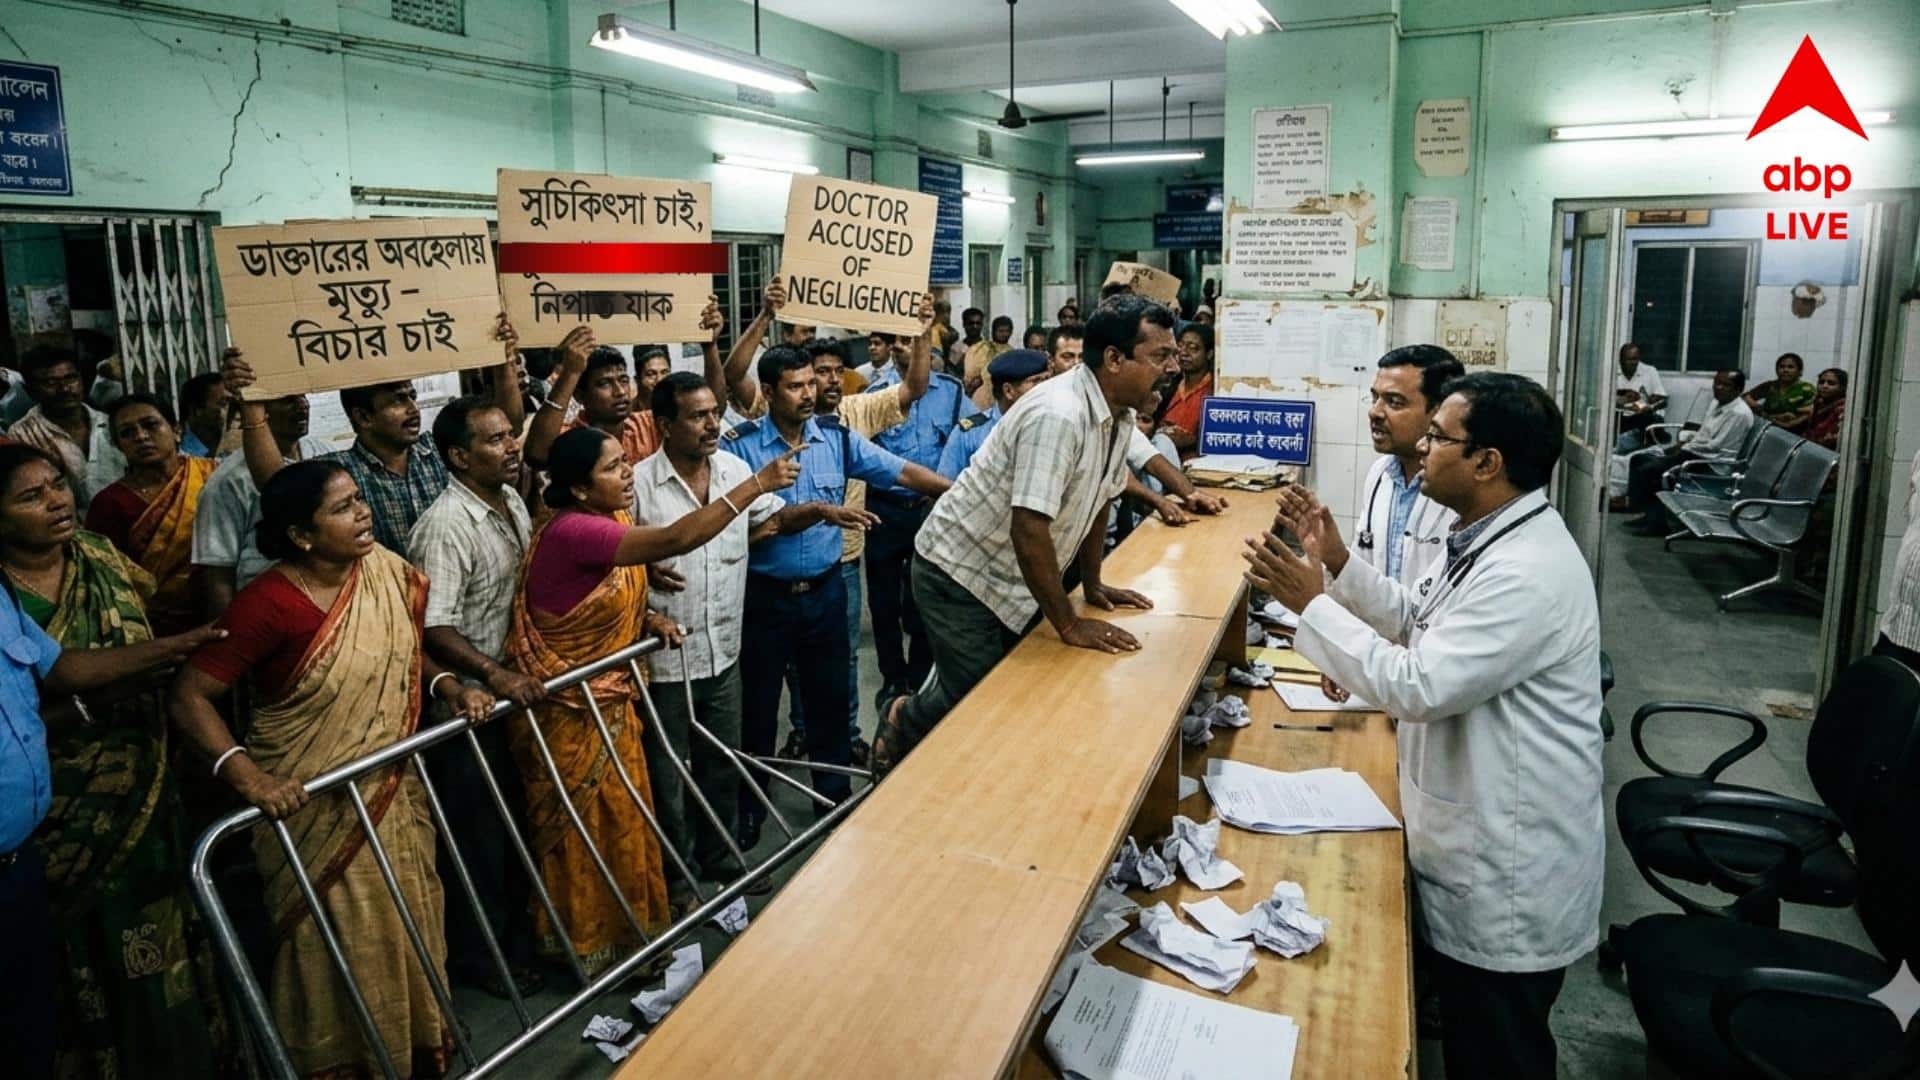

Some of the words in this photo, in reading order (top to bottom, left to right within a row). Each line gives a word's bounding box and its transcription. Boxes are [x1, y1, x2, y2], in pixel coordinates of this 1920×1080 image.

[518, 178, 647, 230] সুচিকিৎসা
[654, 188, 703, 233] চাই,
[814, 185, 909, 226] DOCTOR
[237, 239, 370, 277] ডাক্তারের
[375, 233, 486, 270] অবহেলায়
[808, 218, 913, 257] ACCUSED
[842, 255, 871, 277] OF
[318, 280, 391, 322] মৃত্যু
[623, 289, 674, 321] যাক
[787, 275, 922, 318] NEGLIGENCE
[288, 319, 387, 366] বিচার
[397, 309, 459, 352] চাই
